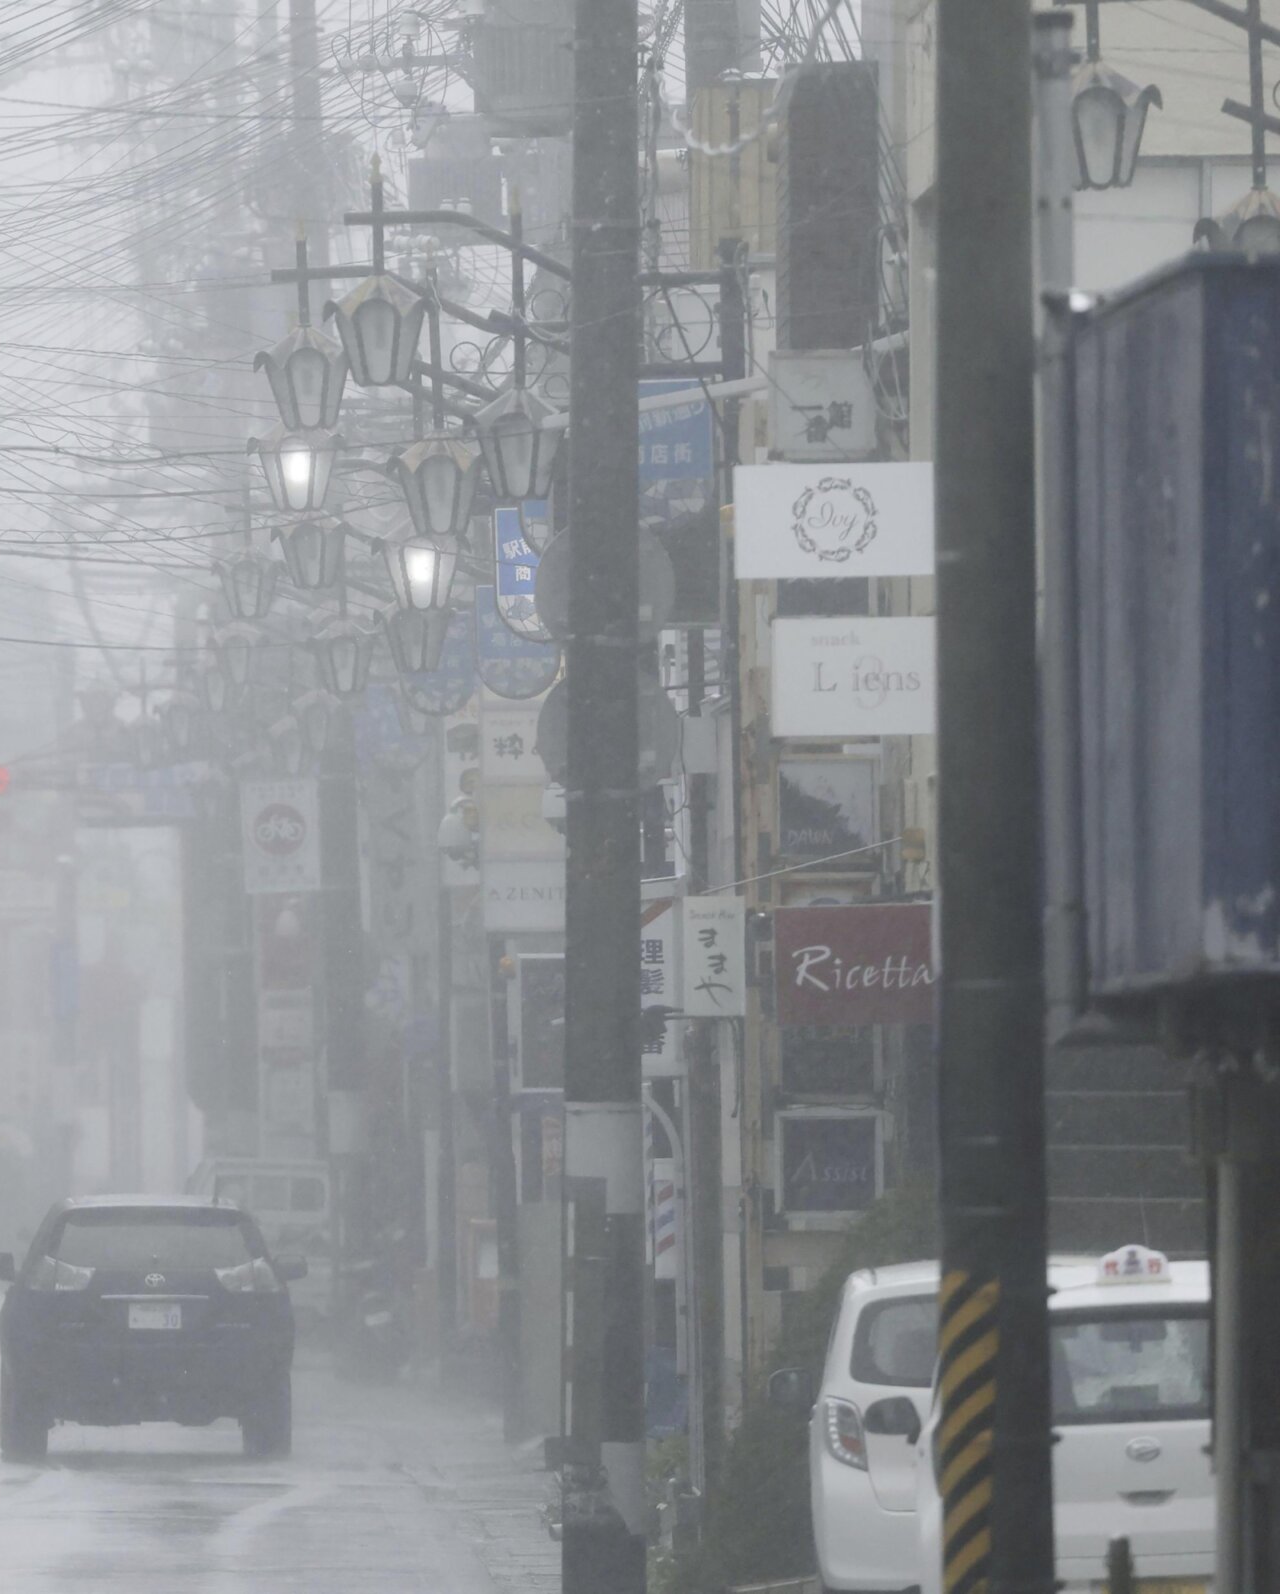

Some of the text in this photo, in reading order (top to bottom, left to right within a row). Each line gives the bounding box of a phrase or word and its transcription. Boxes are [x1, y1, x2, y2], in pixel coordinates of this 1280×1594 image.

[807, 503, 860, 541] Ivy
[693, 928, 733, 1008] ままや
[792, 944, 933, 992] Ricetta
